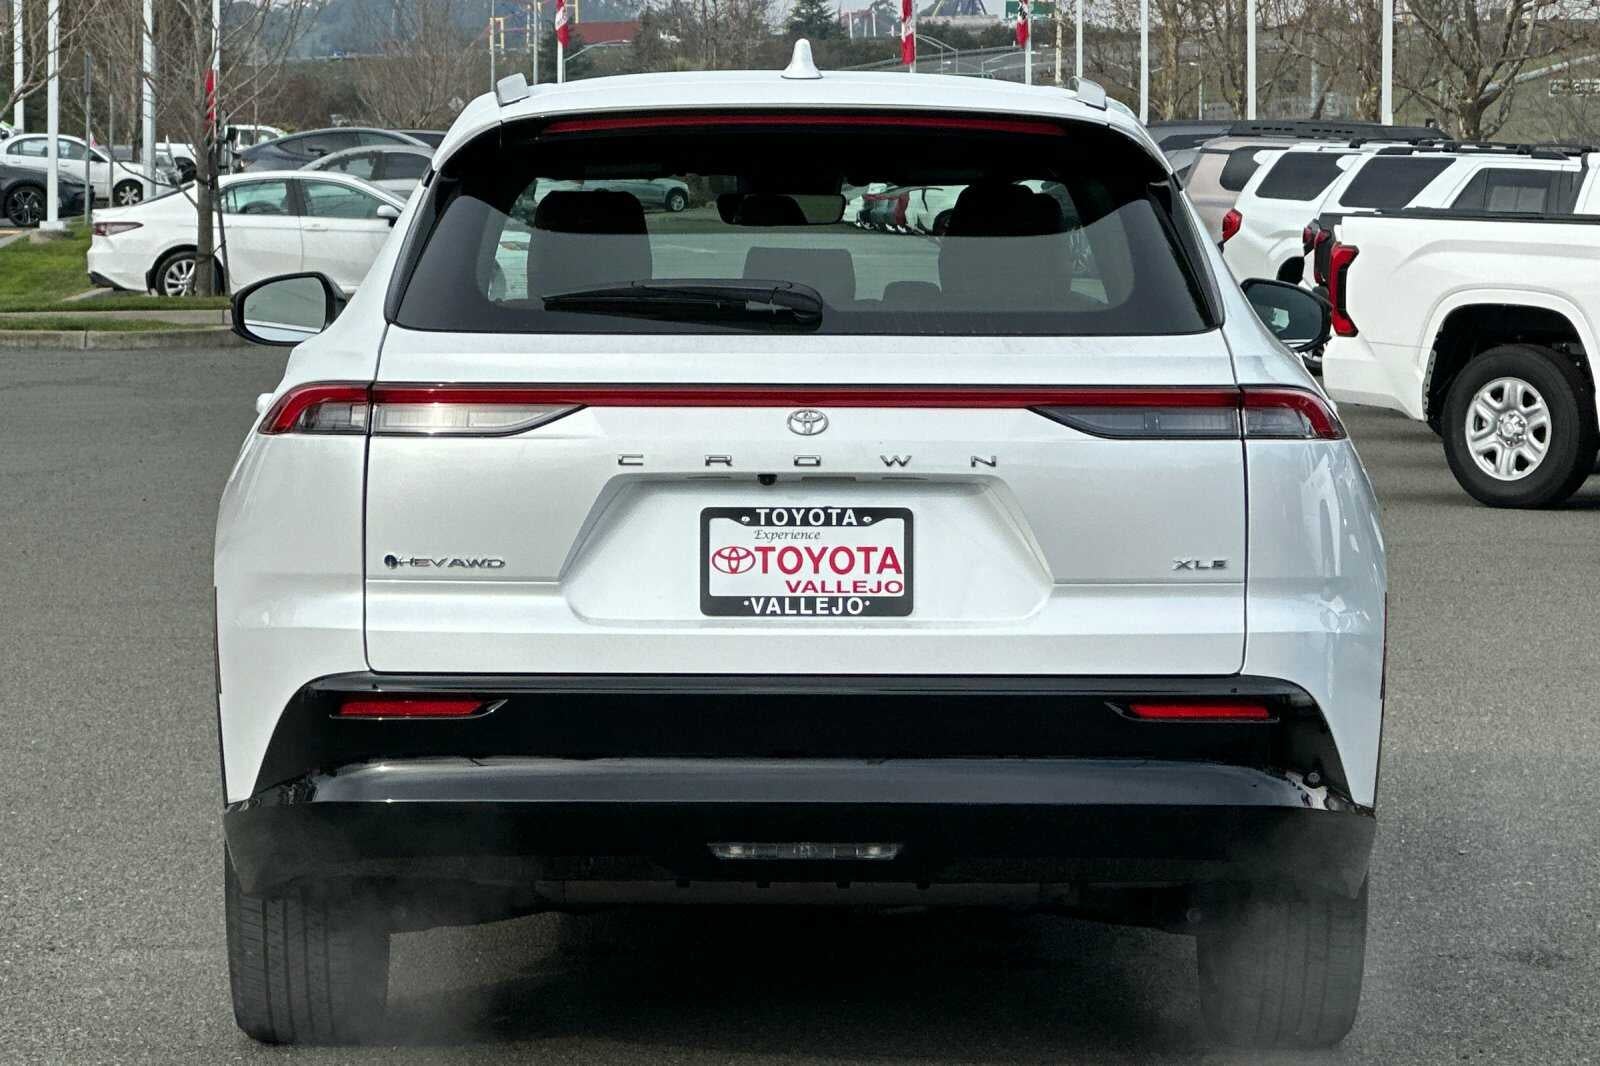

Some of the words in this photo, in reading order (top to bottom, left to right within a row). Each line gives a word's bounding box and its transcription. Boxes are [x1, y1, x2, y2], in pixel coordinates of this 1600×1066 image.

[617, 454, 997, 467] CROWN
[756, 509, 857, 526] TOYOTA
[753, 529, 821, 542] Experience
[754, 546, 903, 574] TOYOTA
[1172, 560, 1226, 570] XLE
[785, 580, 904, 594] VALLEJO
[750, 597, 864, 615] VALLEJO
